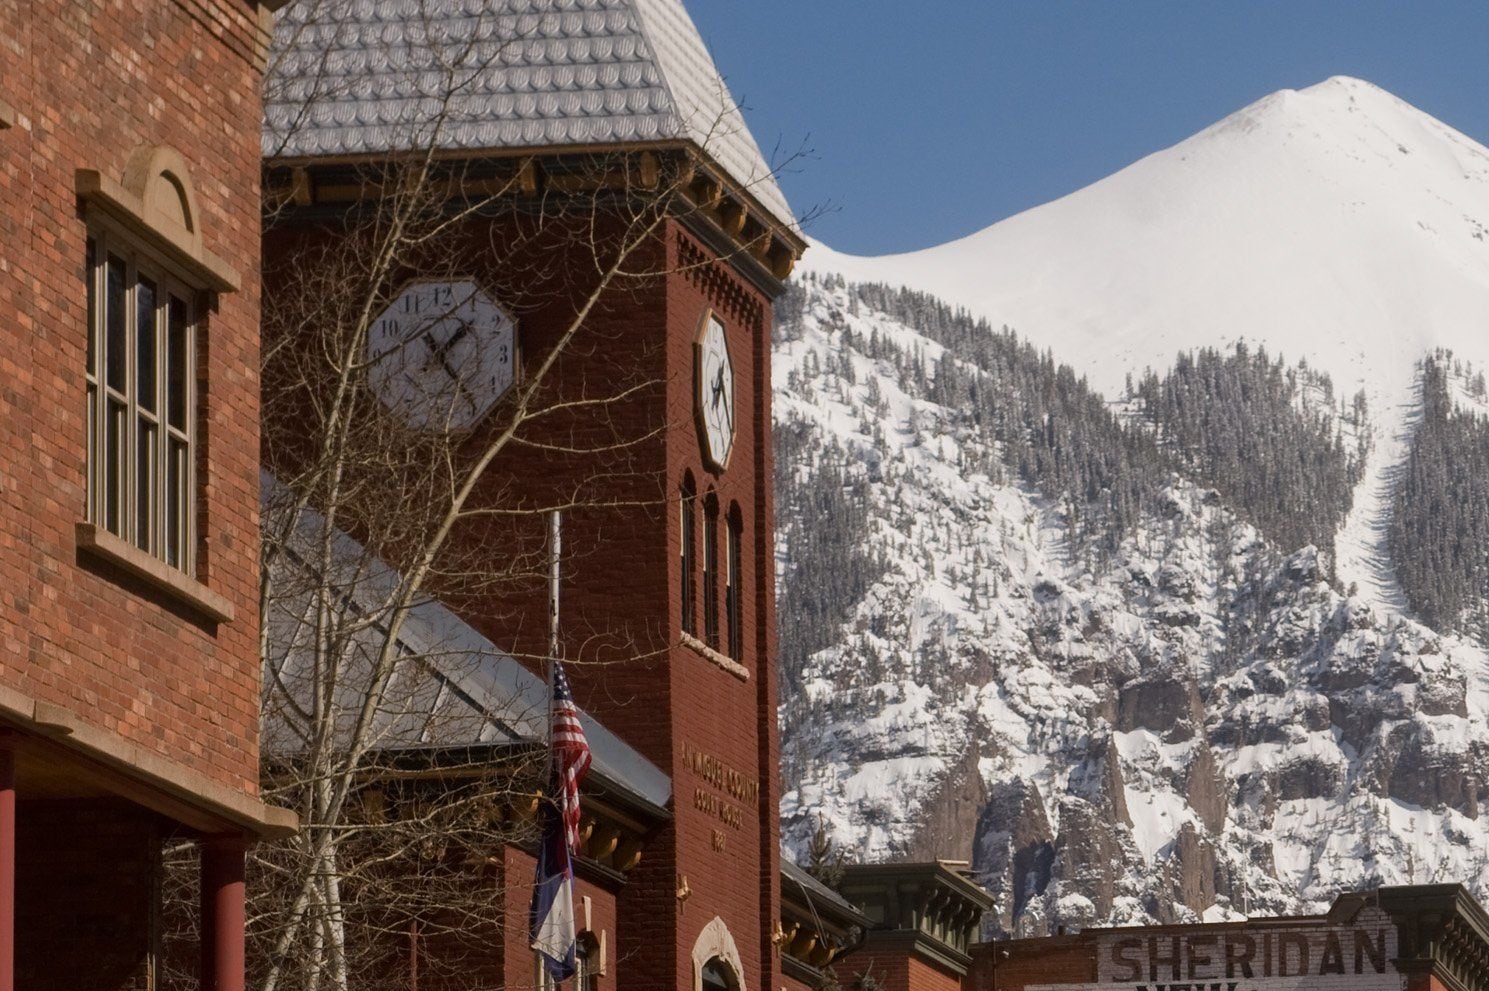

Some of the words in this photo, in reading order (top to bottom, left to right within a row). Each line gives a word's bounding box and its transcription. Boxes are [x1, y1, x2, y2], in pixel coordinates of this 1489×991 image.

[404, 294, 418, 314] 11
[432, 286, 451, 307] 12
[380, 319, 397, 338] 10
[497, 345, 507, 364] 3
[1111, 929, 1386, 983] SHERIDAN
